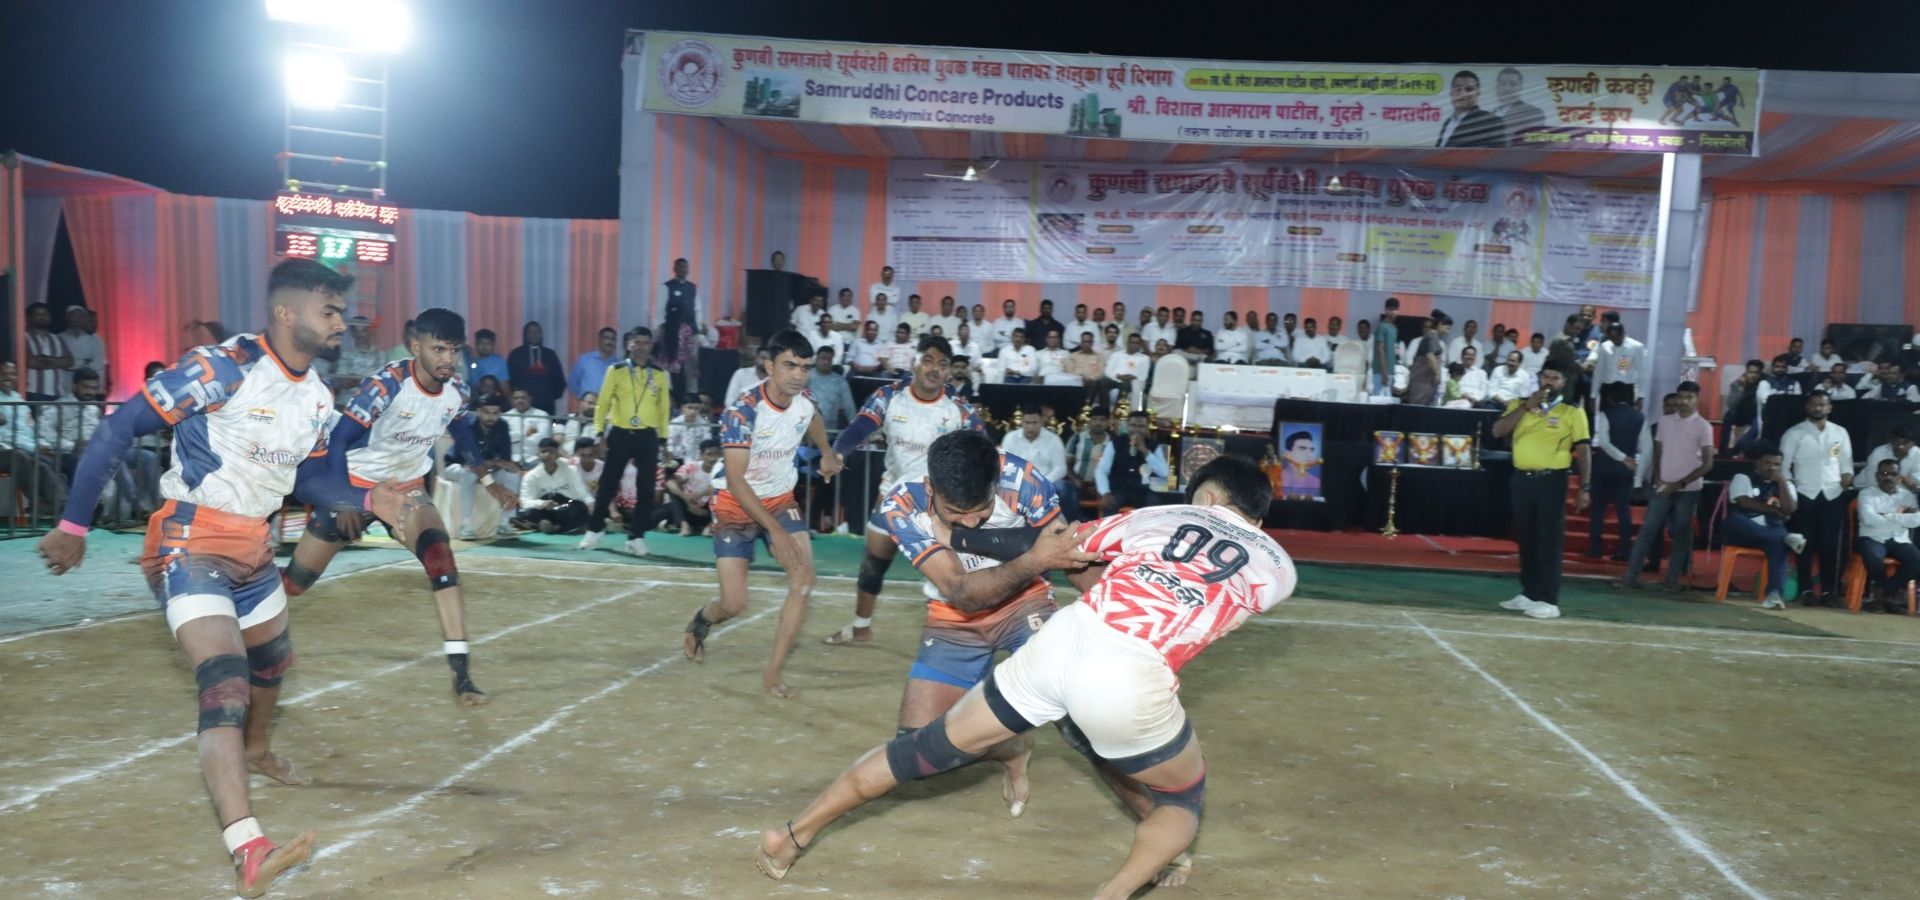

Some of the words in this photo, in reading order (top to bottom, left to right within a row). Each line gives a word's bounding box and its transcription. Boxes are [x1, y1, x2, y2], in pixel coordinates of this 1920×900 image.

[732, 46, 773, 70] कुणबी
[777, 49, 832, 69] समाजाचे
[837, 50, 887, 78] सूर्यवंशी
[892, 53, 930, 74] क्षत्रिय
[936, 58, 968, 81] युवक
[972, 55, 1003, 78] मंडळ
[1007, 63, 1051, 80] पालघर
[1056, 66, 1102, 88] तालुका
[1107, 62, 1127, 90] पूर्व
[1131, 64, 1174, 86] विभाग
[804, 79, 902, 100] Samruddhi
[904, 84, 979, 105] Concare
[982, 88, 1065, 109] Products
[1546, 72, 1600, 103] कुणबी
[1604, 73, 1656, 105] कबड्डी
[870, 107, 932, 122] Readymix
[935, 110, 995, 125] Concrete
[1128, 95, 1150, 115] श्री.
[1156, 97, 1204, 117] विशाल
[1208, 103, 1271, 119] आत्माराम
[1276, 101, 1324, 123] पाटील,
[1087, 169, 1148, 200] कुणबी
[1162, 523, 1250, 584] 09
